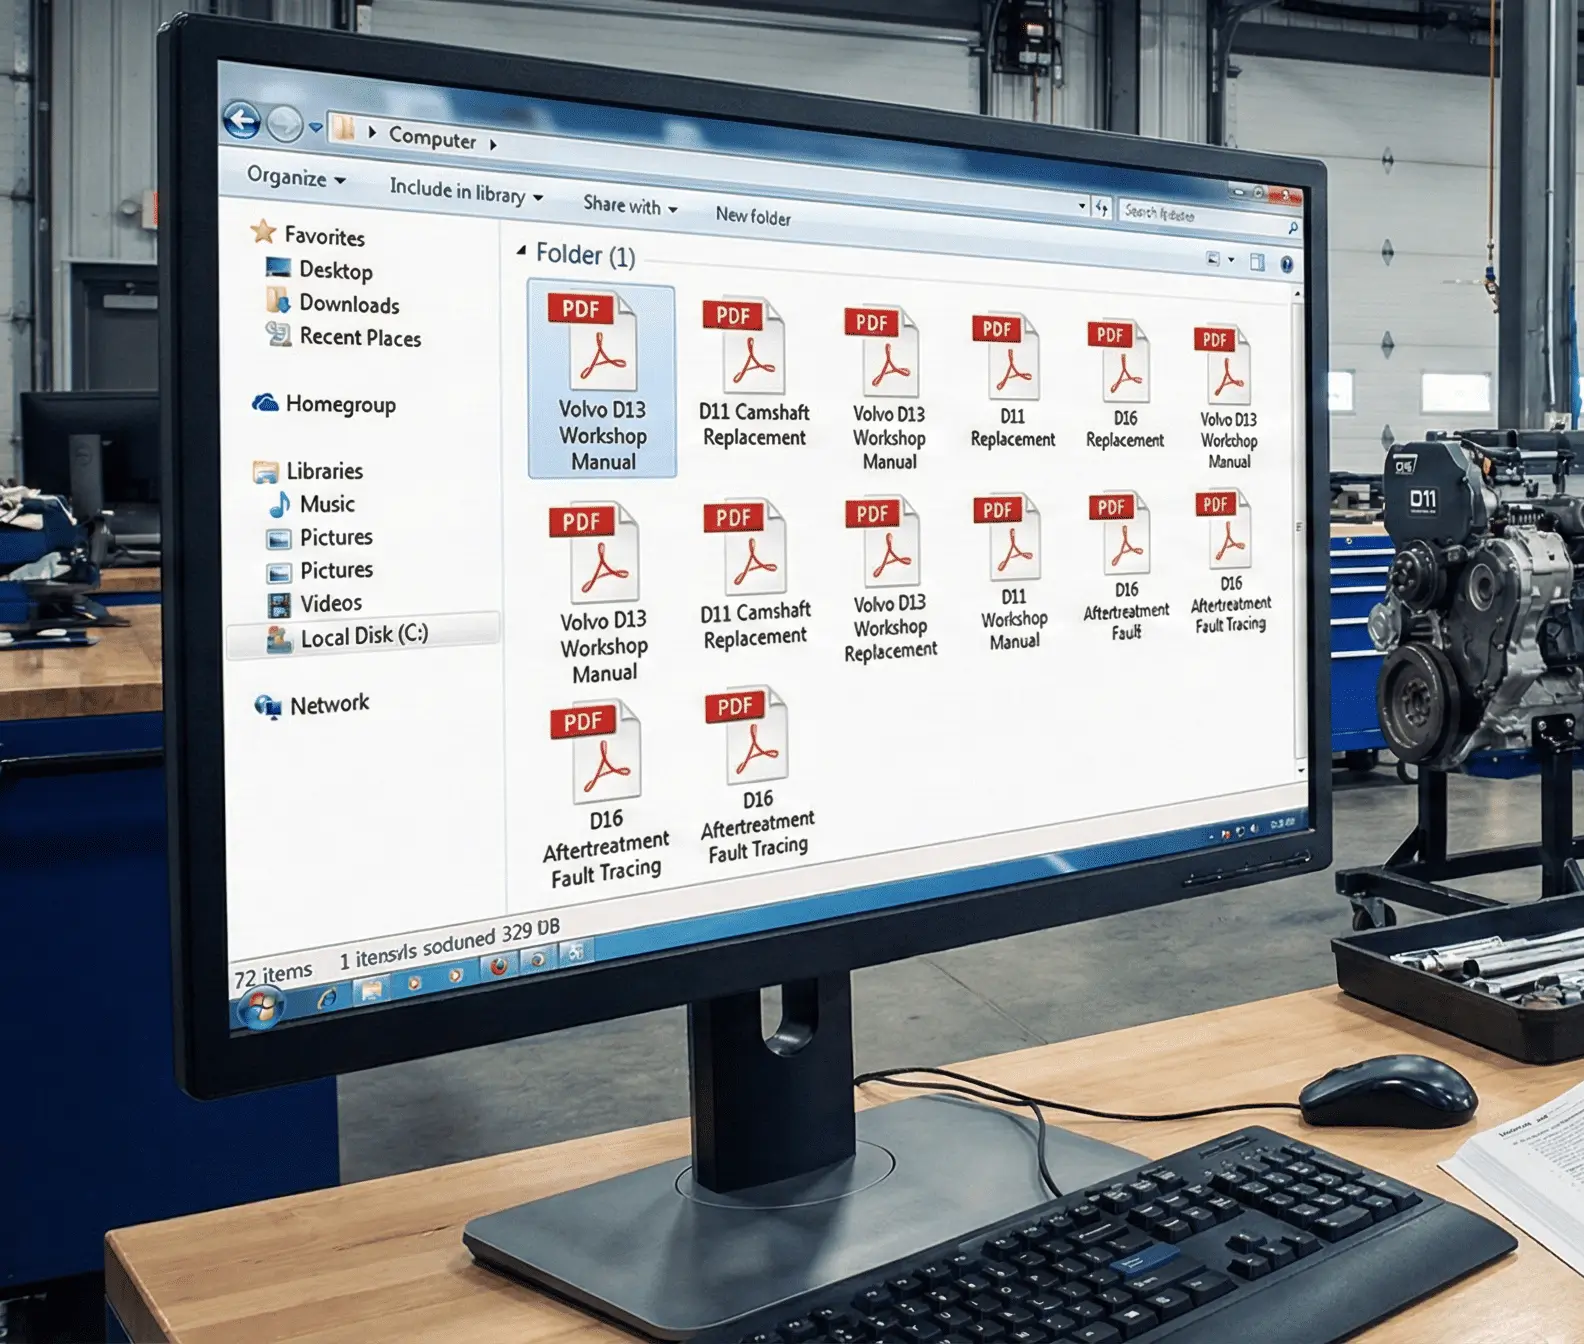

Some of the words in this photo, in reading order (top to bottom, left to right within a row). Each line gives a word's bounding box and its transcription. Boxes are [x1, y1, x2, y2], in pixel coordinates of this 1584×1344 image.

[389, 126, 477, 153] Computer
[247, 165, 327, 189] Organize
[390, 177, 452, 199] Include
[457, 182, 471, 200] in
[476, 184, 526, 207] library
[584, 194, 625, 213] Share
[629, 197, 661, 215] with
[716, 206, 747, 225] New
[751, 209, 791, 227] folder
[285, 225, 365, 247] Favorites
[537, 242, 602, 266] Folder
[609, 245, 635, 271] (1)
[300, 260, 373, 284] Desktop
[300, 293, 399, 316] Downloads
[563, 299, 599, 318] PDF
[717, 307, 750, 325] PDF
[856, 314, 887, 331] PDF
[301, 326, 361, 347] Recent
[367, 330, 421, 349] Places
[983, 321, 1011, 337] PDF
[1097, 328, 1123, 343] PDF
[1203, 332, 1227, 348] PDF
[287, 395, 396, 417] Homegroup
[559, 400, 607, 418] Volvo
[613, 401, 646, 418] D13
[700, 402, 730, 420] D11
[735, 402, 810, 421] Camshaft
[854, 405, 894, 422] Volvo
[898, 406, 925, 422] D13
[1001, 409, 1025, 424] D11
[1114, 410, 1138, 426] D16
[1201, 412, 1232, 427] Volvo
[1235, 412, 1257, 427] D13
[559, 426, 648, 447] Workshop
[704, 429, 806, 448] Replacement
[854, 429, 925, 448] Workshop
[971, 431, 1056, 448] Replacement
[1086, 432, 1164, 449] Replacement
[572, 452, 636, 470] Manual
[863, 454, 917, 469] Manual
[1209, 455, 1251, 469] Manual
[287, 462, 363, 480] Libraries
[301, 495, 355, 513] Music
[1098, 500, 1125, 515] PDF
[1203, 497, 1228, 512] PDF
[1410, 489, 1436, 507] D11
[717, 509, 750, 527] PDF
[856, 505, 888, 522] PDF
[983, 503, 1012, 519] PDF
[563, 513, 600, 531] PDF
[301, 528, 373, 547] Pictures
[301, 562, 373, 580] Pictures
[1115, 582, 1139, 598] D16
[1221, 576, 1242, 591] D16
[301, 595, 362, 613] Videos
[854, 597, 894, 613] Volvo
[899, 594, 926, 610] D13
[1002, 589, 1027, 605] D11
[1191, 596, 1272, 614] Aftertreatment
[560, 614, 608, 631] Volvo
[614, 610, 647, 628] D13
[700, 606, 730, 624] D11
[737, 600, 811, 621] Camshaft
[981, 612, 1049, 630] Workshop
[1084, 603, 1170, 621] Aftertreatment
[854, 619, 928, 637] Workshop
[1196, 617, 1224, 633] Fault
[1226, 616, 1266, 633] Tracing
[302, 627, 349, 648] Local
[356, 624, 394, 645] Disk
[398, 623, 429, 645] (C:)
[704, 628, 807, 651] Replacement
[990, 634, 1040, 651] Manual
[560, 638, 648, 658] Workshop
[845, 642, 937, 664] Replacement
[573, 663, 637, 683] Manual
[291, 692, 369, 716] Network
[718, 697, 753, 716] PDF
[565, 712, 602, 732] PDF
[743, 789, 773, 809] D16
[590, 808, 623, 831] D16
[701, 810, 815, 840] Aftertreatment
[543, 831, 669, 863] Aftertreatment
[709, 845, 748, 864] Fault
[752, 836, 808, 858] Tracing
[552, 864, 594, 889] Fault
[600, 858, 661, 883] Tracing
[340, 953, 349, 970] 1
[502, 923, 533, 943] 329
[235, 970, 256, 990] 72
[262, 961, 313, 984] items
